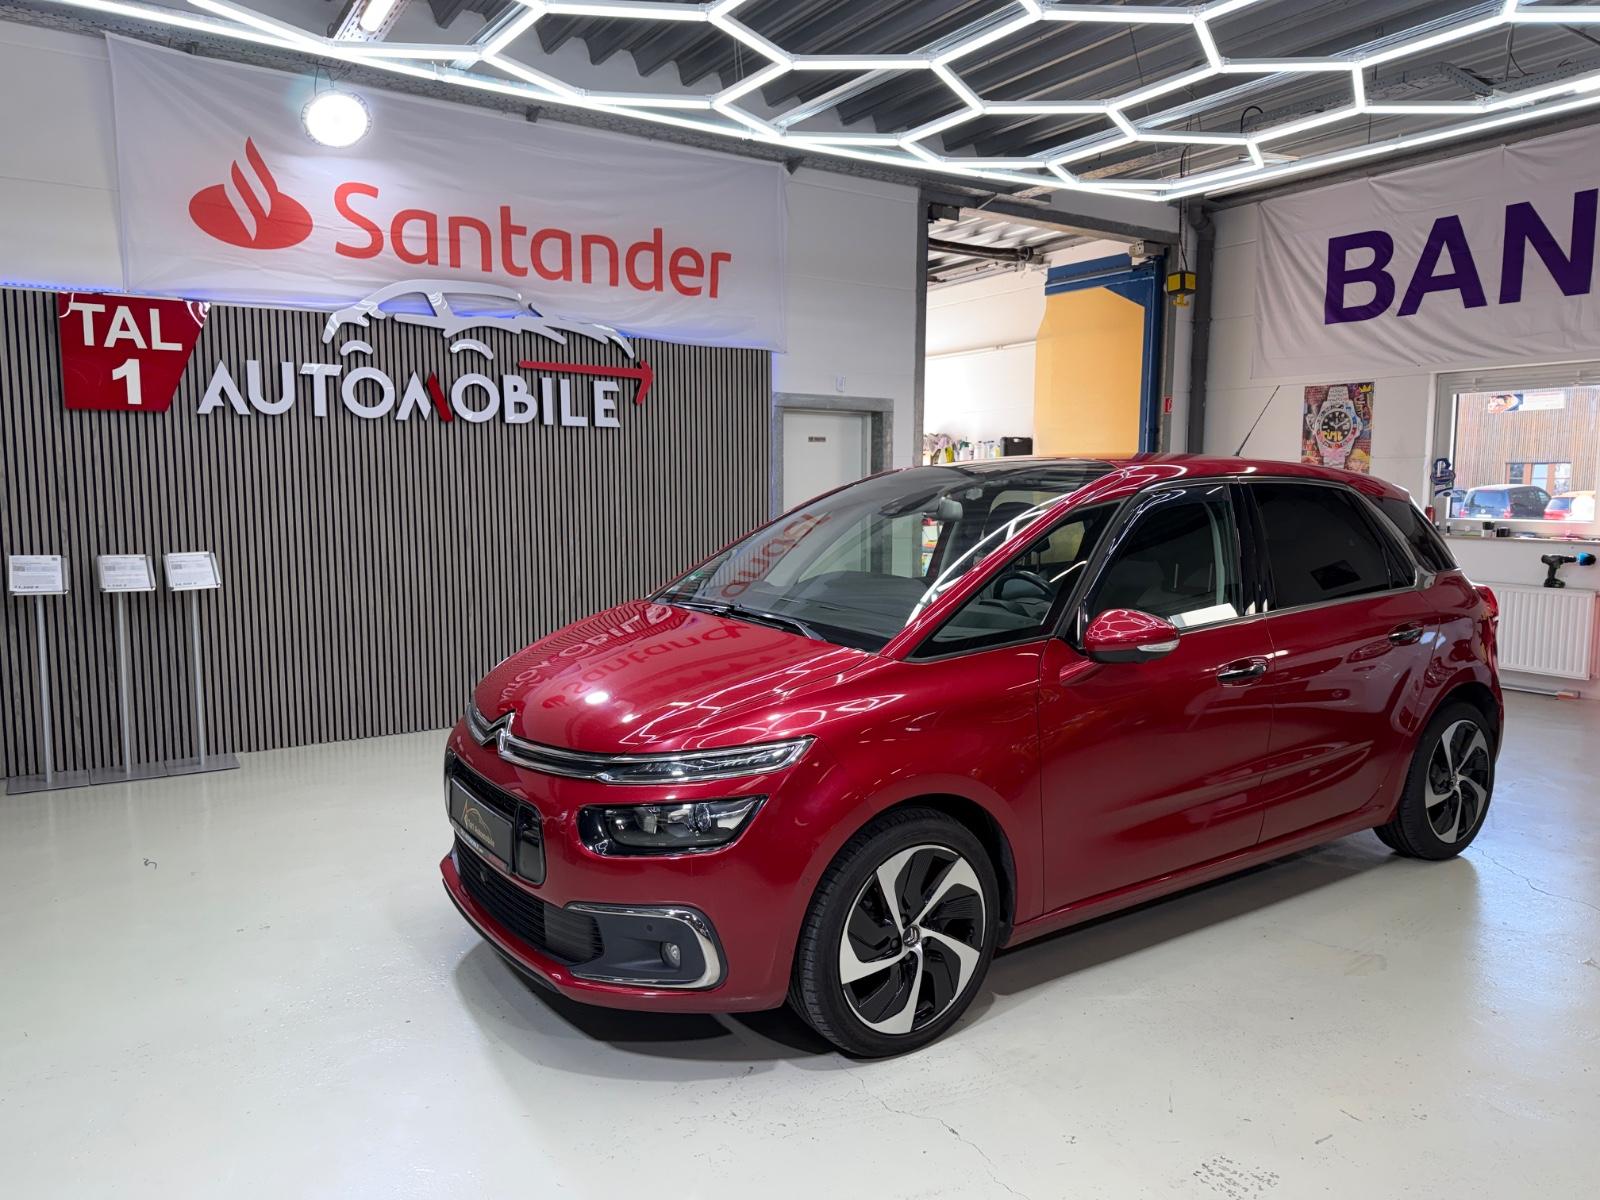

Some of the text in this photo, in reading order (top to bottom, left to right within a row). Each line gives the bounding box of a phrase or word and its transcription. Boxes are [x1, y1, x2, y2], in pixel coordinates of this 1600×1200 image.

[333, 182, 732, 298] Santander
[1325, 188, 1599, 325] BAN
[69, 301, 183, 351] TAL
[111, 358, 142, 405] 1
[196, 359, 621, 428] AUTOMOBILE
